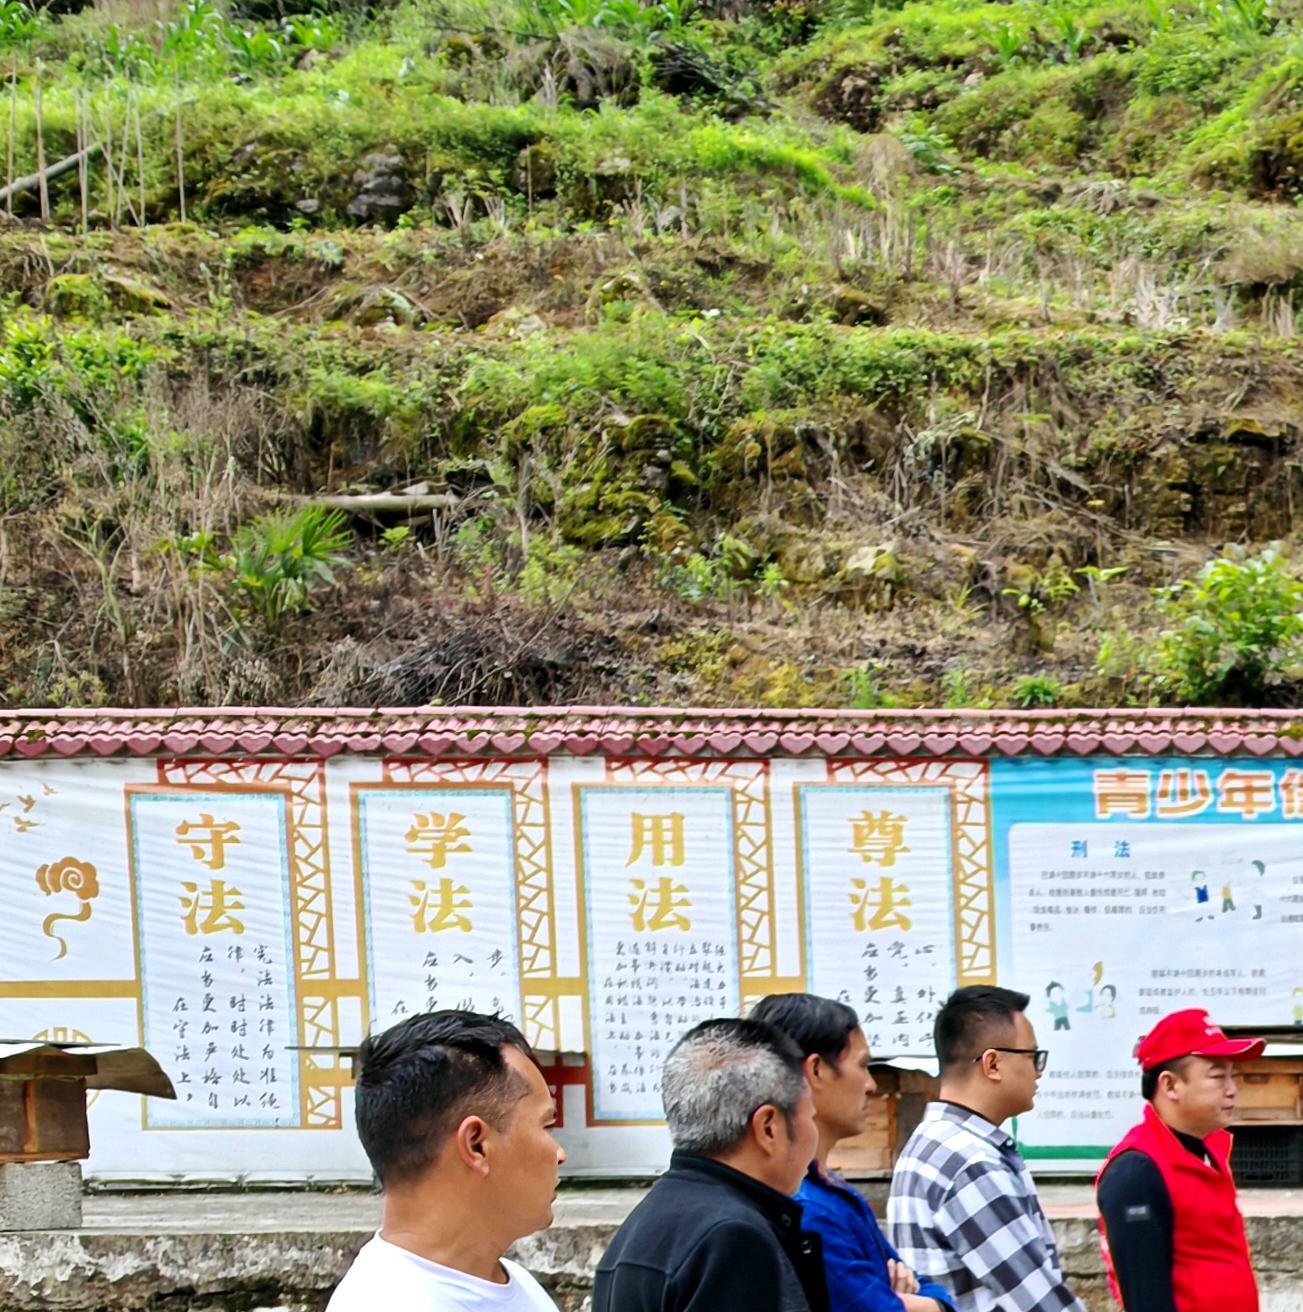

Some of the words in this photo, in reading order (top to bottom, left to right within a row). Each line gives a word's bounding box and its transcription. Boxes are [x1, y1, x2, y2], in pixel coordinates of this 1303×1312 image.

[176, 814, 247, 935] 守法
[404, 812, 473, 933] 学法
[628, 811, 693, 932] 用法
[847, 810, 914, 932] 尊法
